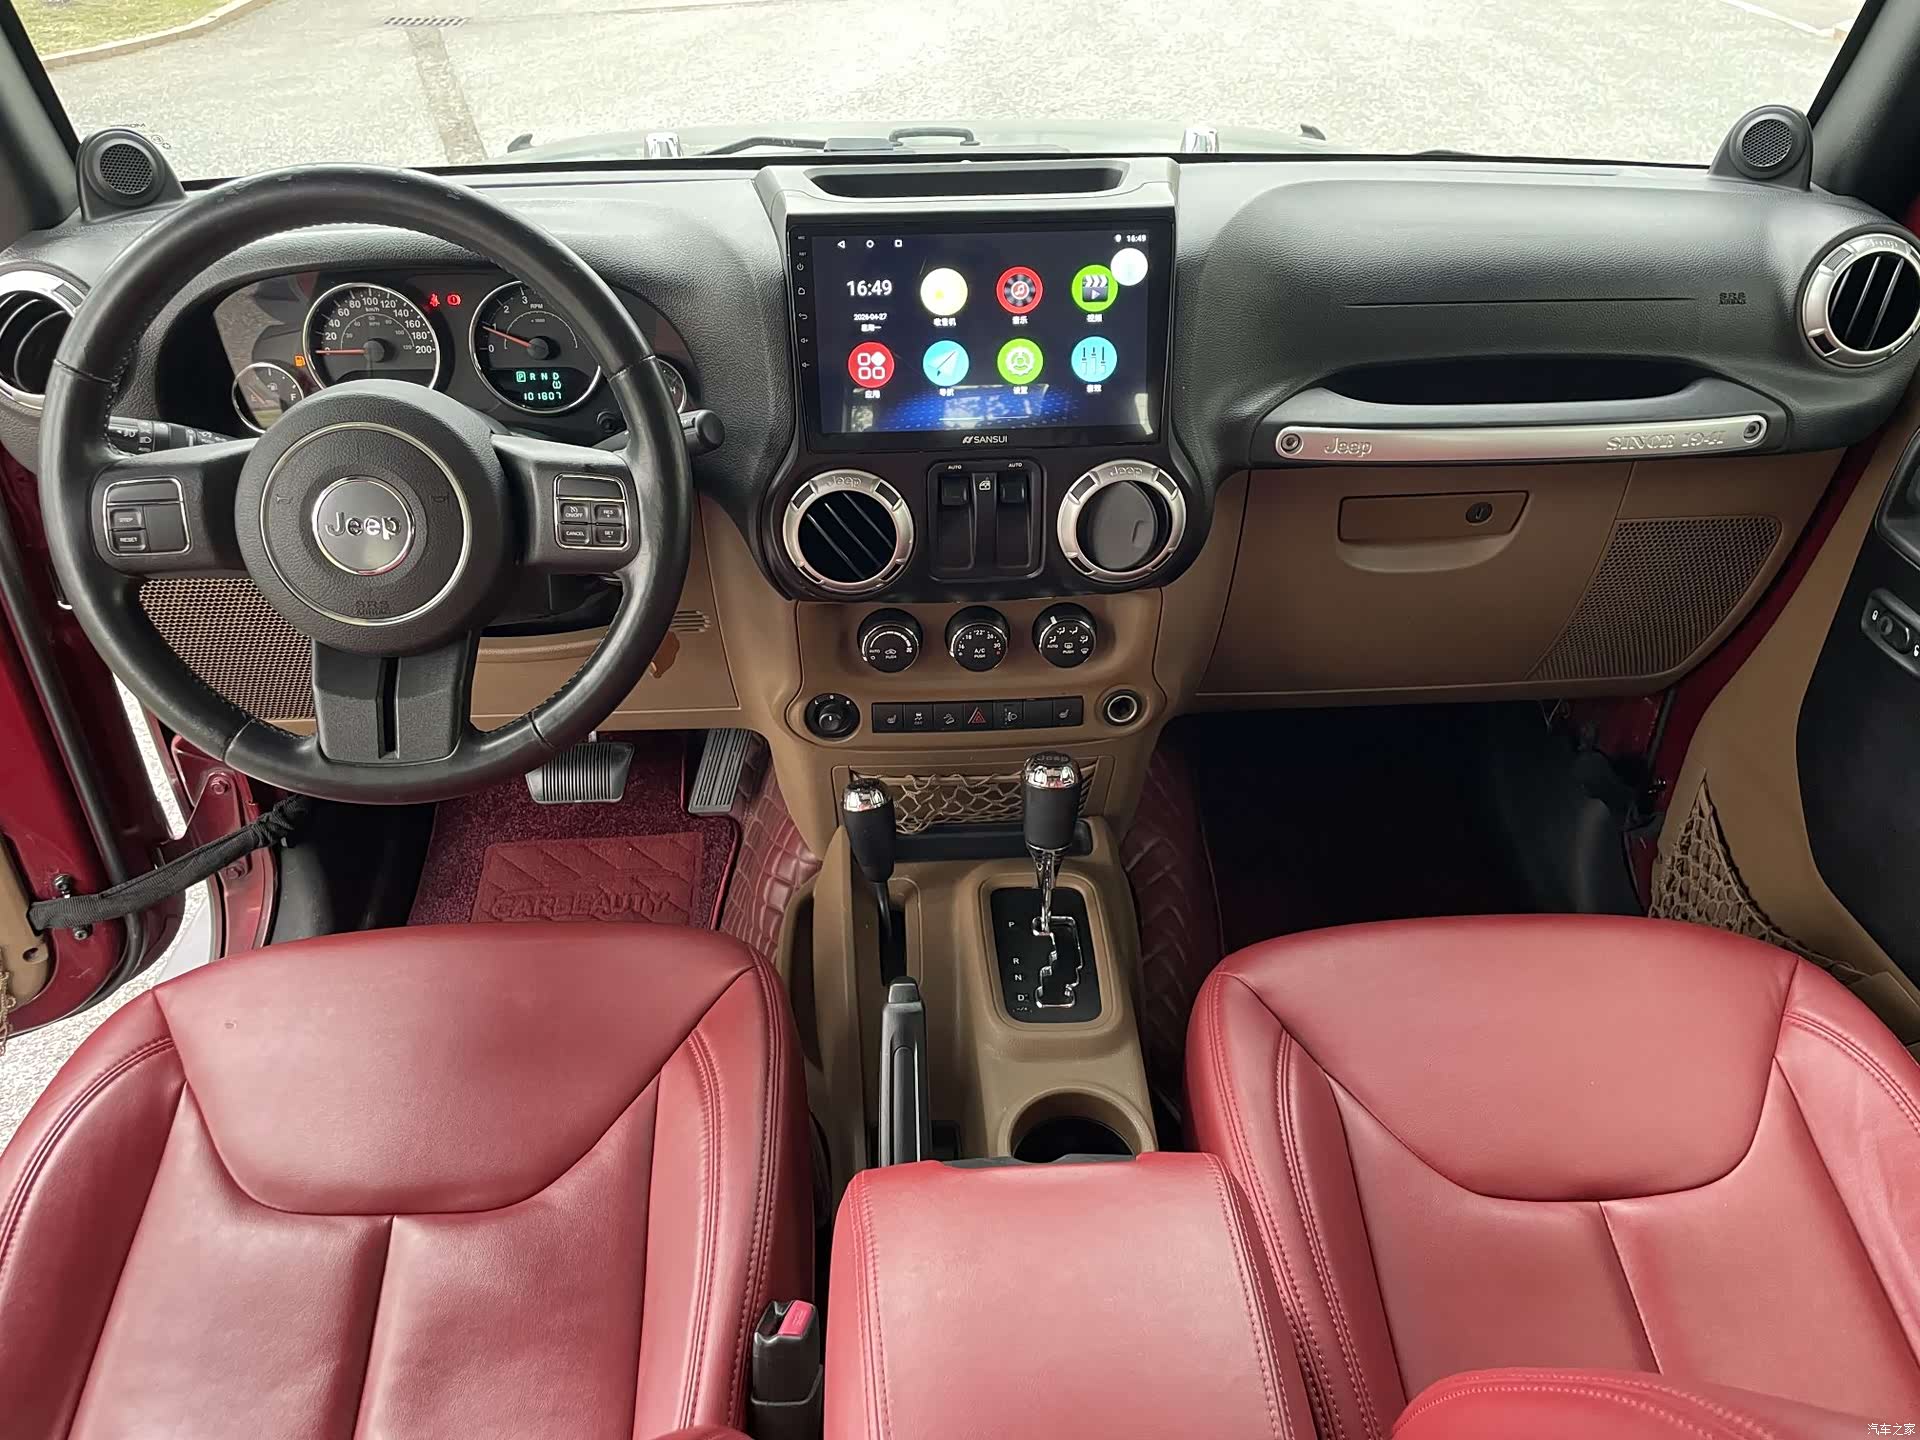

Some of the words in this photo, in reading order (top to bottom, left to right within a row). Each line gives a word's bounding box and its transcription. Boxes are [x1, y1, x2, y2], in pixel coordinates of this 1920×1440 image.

[1126, 234, 1147, 242] 16:49
[846, 279, 893, 296] 16:49
[349, 300, 361, 309] 80
[362, 297, 379, 306] 100
[380, 299, 397, 308] 120
[521, 296, 528, 304] 3
[337, 308, 350, 317] 60
[393, 309, 410, 317] 140
[503, 305, 510, 314] 2
[328, 319, 341, 328] 40
[404, 320, 421, 328] 160
[325, 331, 338, 340] 20
[411, 331, 428, 340] 180
[415, 345, 432, 354] 200
[488, 345, 495, 353] 0
[529, 372, 536, 381] R
[541, 372, 548, 380] N
[552, 371, 560, 380] D
[973, 435, 1008, 444] SANSUI
[1605, 433, 1675, 451] SINCE
[1323, 437, 1373, 458] Jeep
[1109, 465, 1143, 478] Jeep
[825, 475, 862, 488] Jeep
[325, 511, 401, 541] Jeep
[1012, 957, 1020, 965] R
